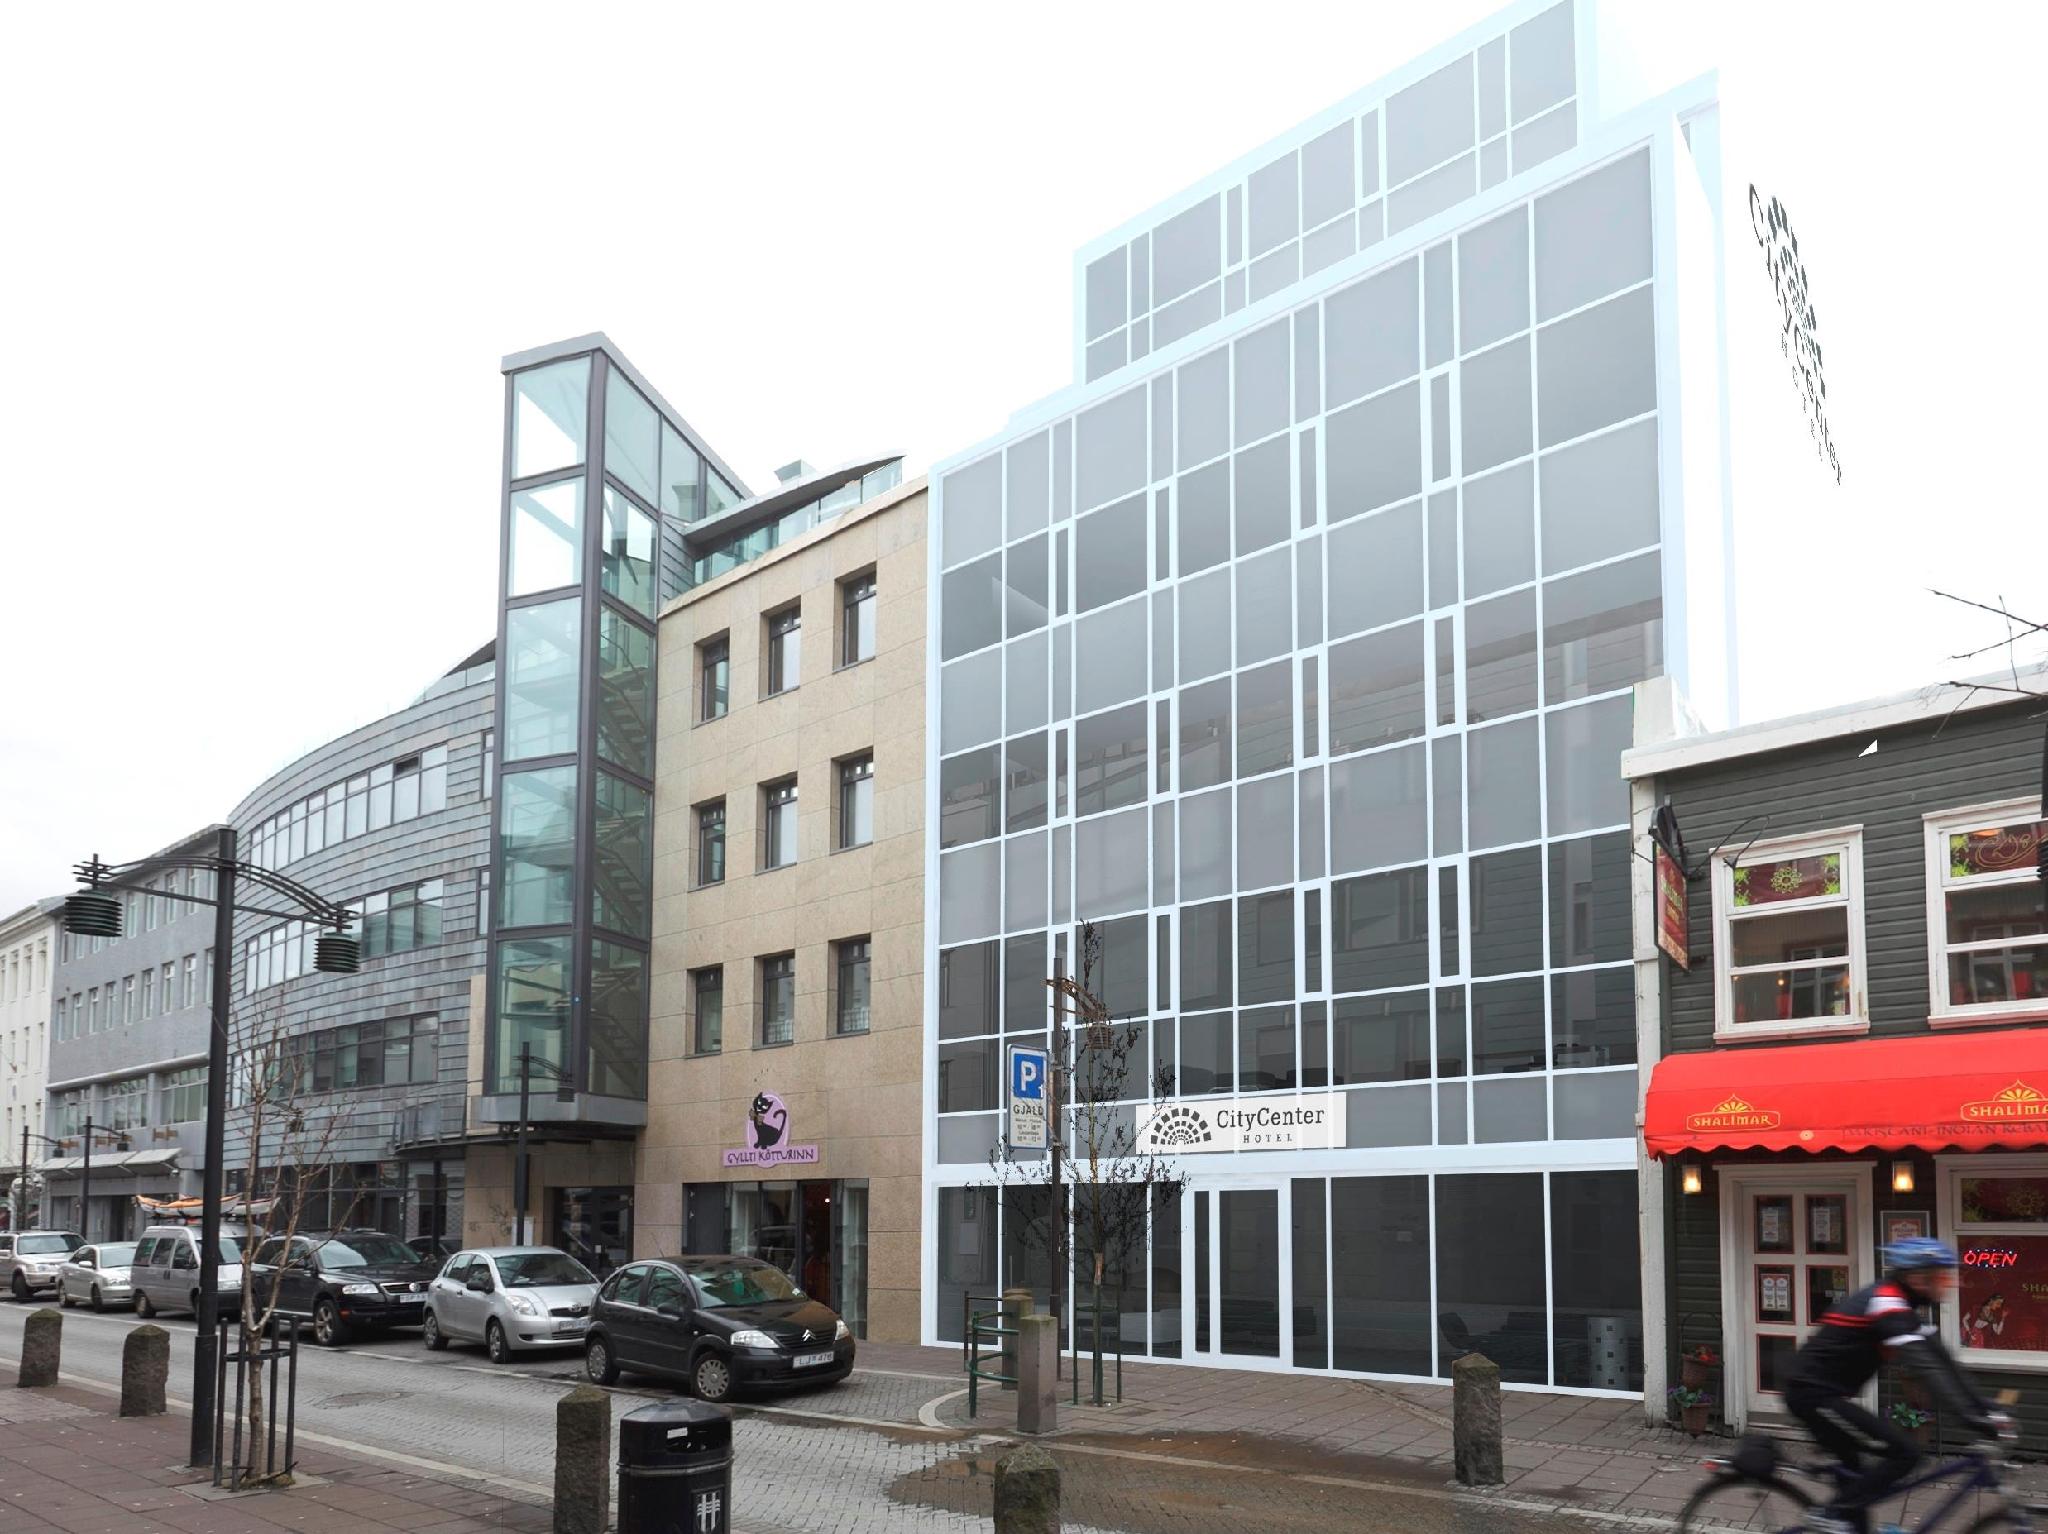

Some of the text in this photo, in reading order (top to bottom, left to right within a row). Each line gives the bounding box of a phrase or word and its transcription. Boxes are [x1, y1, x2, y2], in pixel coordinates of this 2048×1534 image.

[1750, 182, 1841, 485] CityCenter
[1021, 1060, 1037, 1091] P
[1013, 1104, 1044, 1116] GJALD
[1216, 1107, 1325, 1132] CityCenter
[1693, 1115, 1773, 1127] SHALIMAR
[1243, 1133, 1293, 1144] HOTEL
[1963, 1251, 2018, 1266] OPEN
